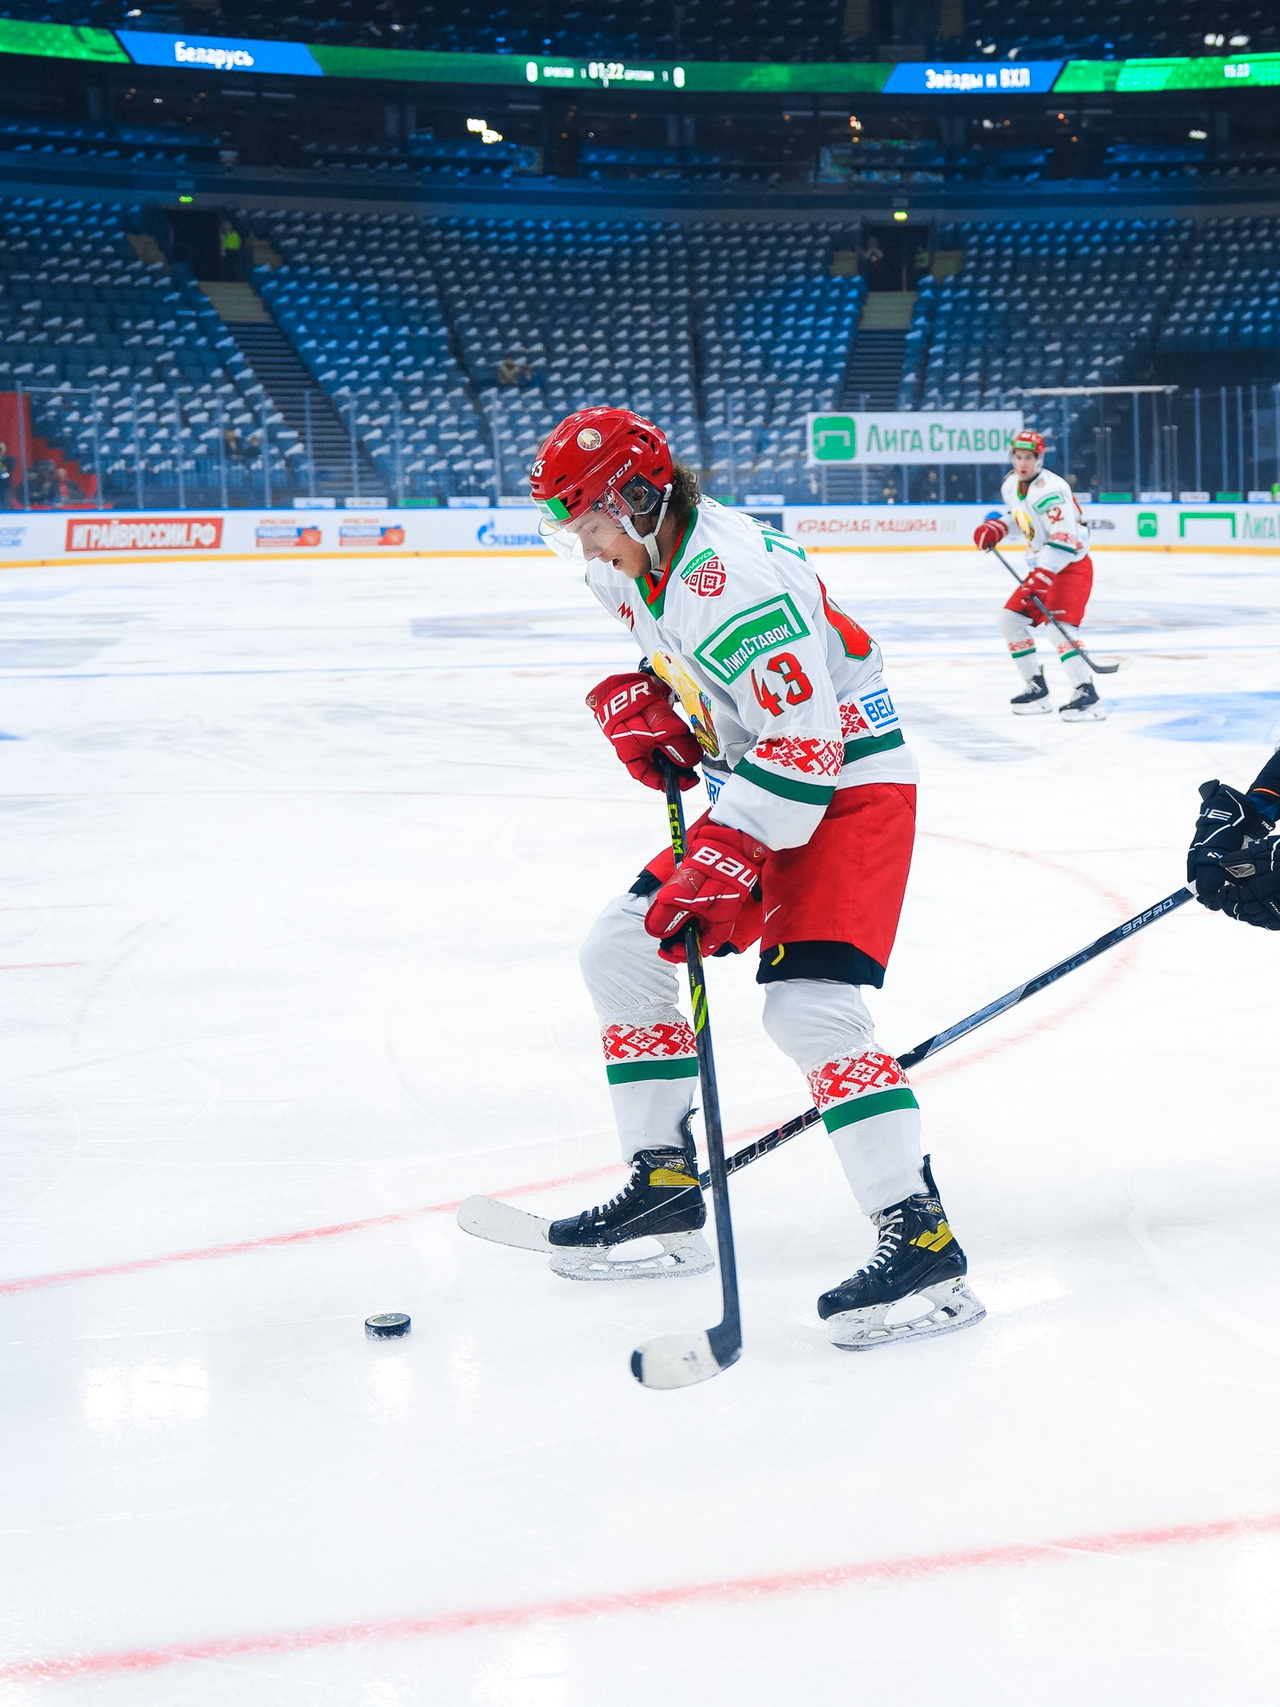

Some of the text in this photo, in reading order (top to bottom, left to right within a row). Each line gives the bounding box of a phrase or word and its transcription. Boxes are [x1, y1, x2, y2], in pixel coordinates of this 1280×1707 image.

[175, 41, 254, 70] Беларусь
[925, 68, 1030, 90] Звёзды и ВХЛ
[606, 459, 632, 486] CCM
[71, 520, 217, 549] ИГРАЙВРОССИИ.РФ
[796, 519, 938, 533] КРАСНАЯ МАШИНА
[682, 551, 714, 580] БЕЛАРУСЬ
[751, 652, 813, 717] 43
[667, 803, 684, 855] CCM
